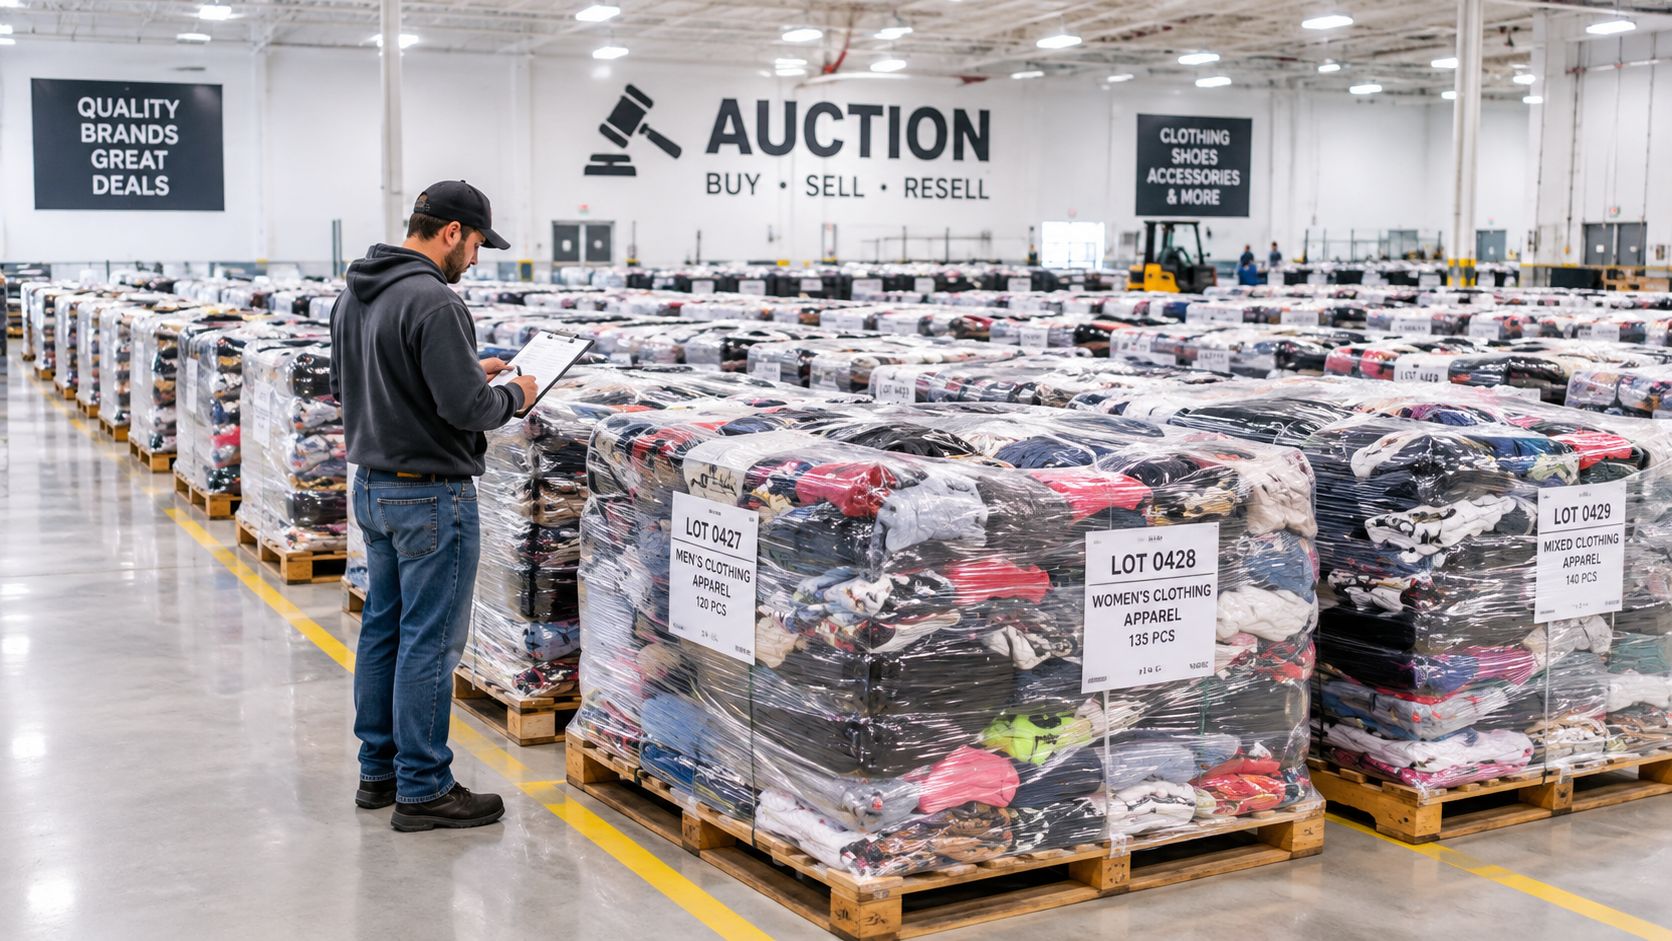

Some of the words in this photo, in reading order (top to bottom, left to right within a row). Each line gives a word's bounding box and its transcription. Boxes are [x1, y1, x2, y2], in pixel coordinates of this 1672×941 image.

[78, 97, 180, 119] QUALITY
[81, 123, 179, 145] BRANDS
[705, 98, 990, 162] AUCTION
[1160, 127, 1231, 146] CLOTHING
[91, 149, 168, 170] GREAT
[1171, 147, 1218, 166] SHOES
[92, 174, 170, 196] DEALS
[706, 172, 761, 195] BUY
[805, 175, 865, 198] SELL
[904, 177, 990, 200] RESELL
[1146, 167, 1241, 186] ACCESSORIES
[1166, 188, 1178, 205] &
[1180, 188, 1221, 206] MORE
[1554, 506, 1579, 525] LOT
[1582, 503, 1611, 522] 0429
[686, 516, 709, 541] LOT
[712, 525, 742, 550] 0427
[1543, 538, 1573, 553] MIXED
[1575, 533, 1620, 550] CLOTHING
[675, 548, 703, 569] MEN'S
[704, 558, 751, 583] CLOTHING
[1111, 552, 1148, 576] LOT
[1152, 549, 1197, 571] 0428
[1562, 553, 1602, 568] APPAREL
[692, 574, 731, 599] APPAREL
[1566, 574, 1580, 585] 140
[1581, 571, 1598, 583] PCS
[696, 595, 709, 610] 120
[710, 600, 727, 616] PCS
[1092, 590, 1150, 609] WOMEN'S
[1153, 584, 1212, 602] CLOTHING
[1123, 607, 1182, 627] APPAREL
[1129, 632, 1149, 647] 135
[1152, 629, 1176, 645] PCS
